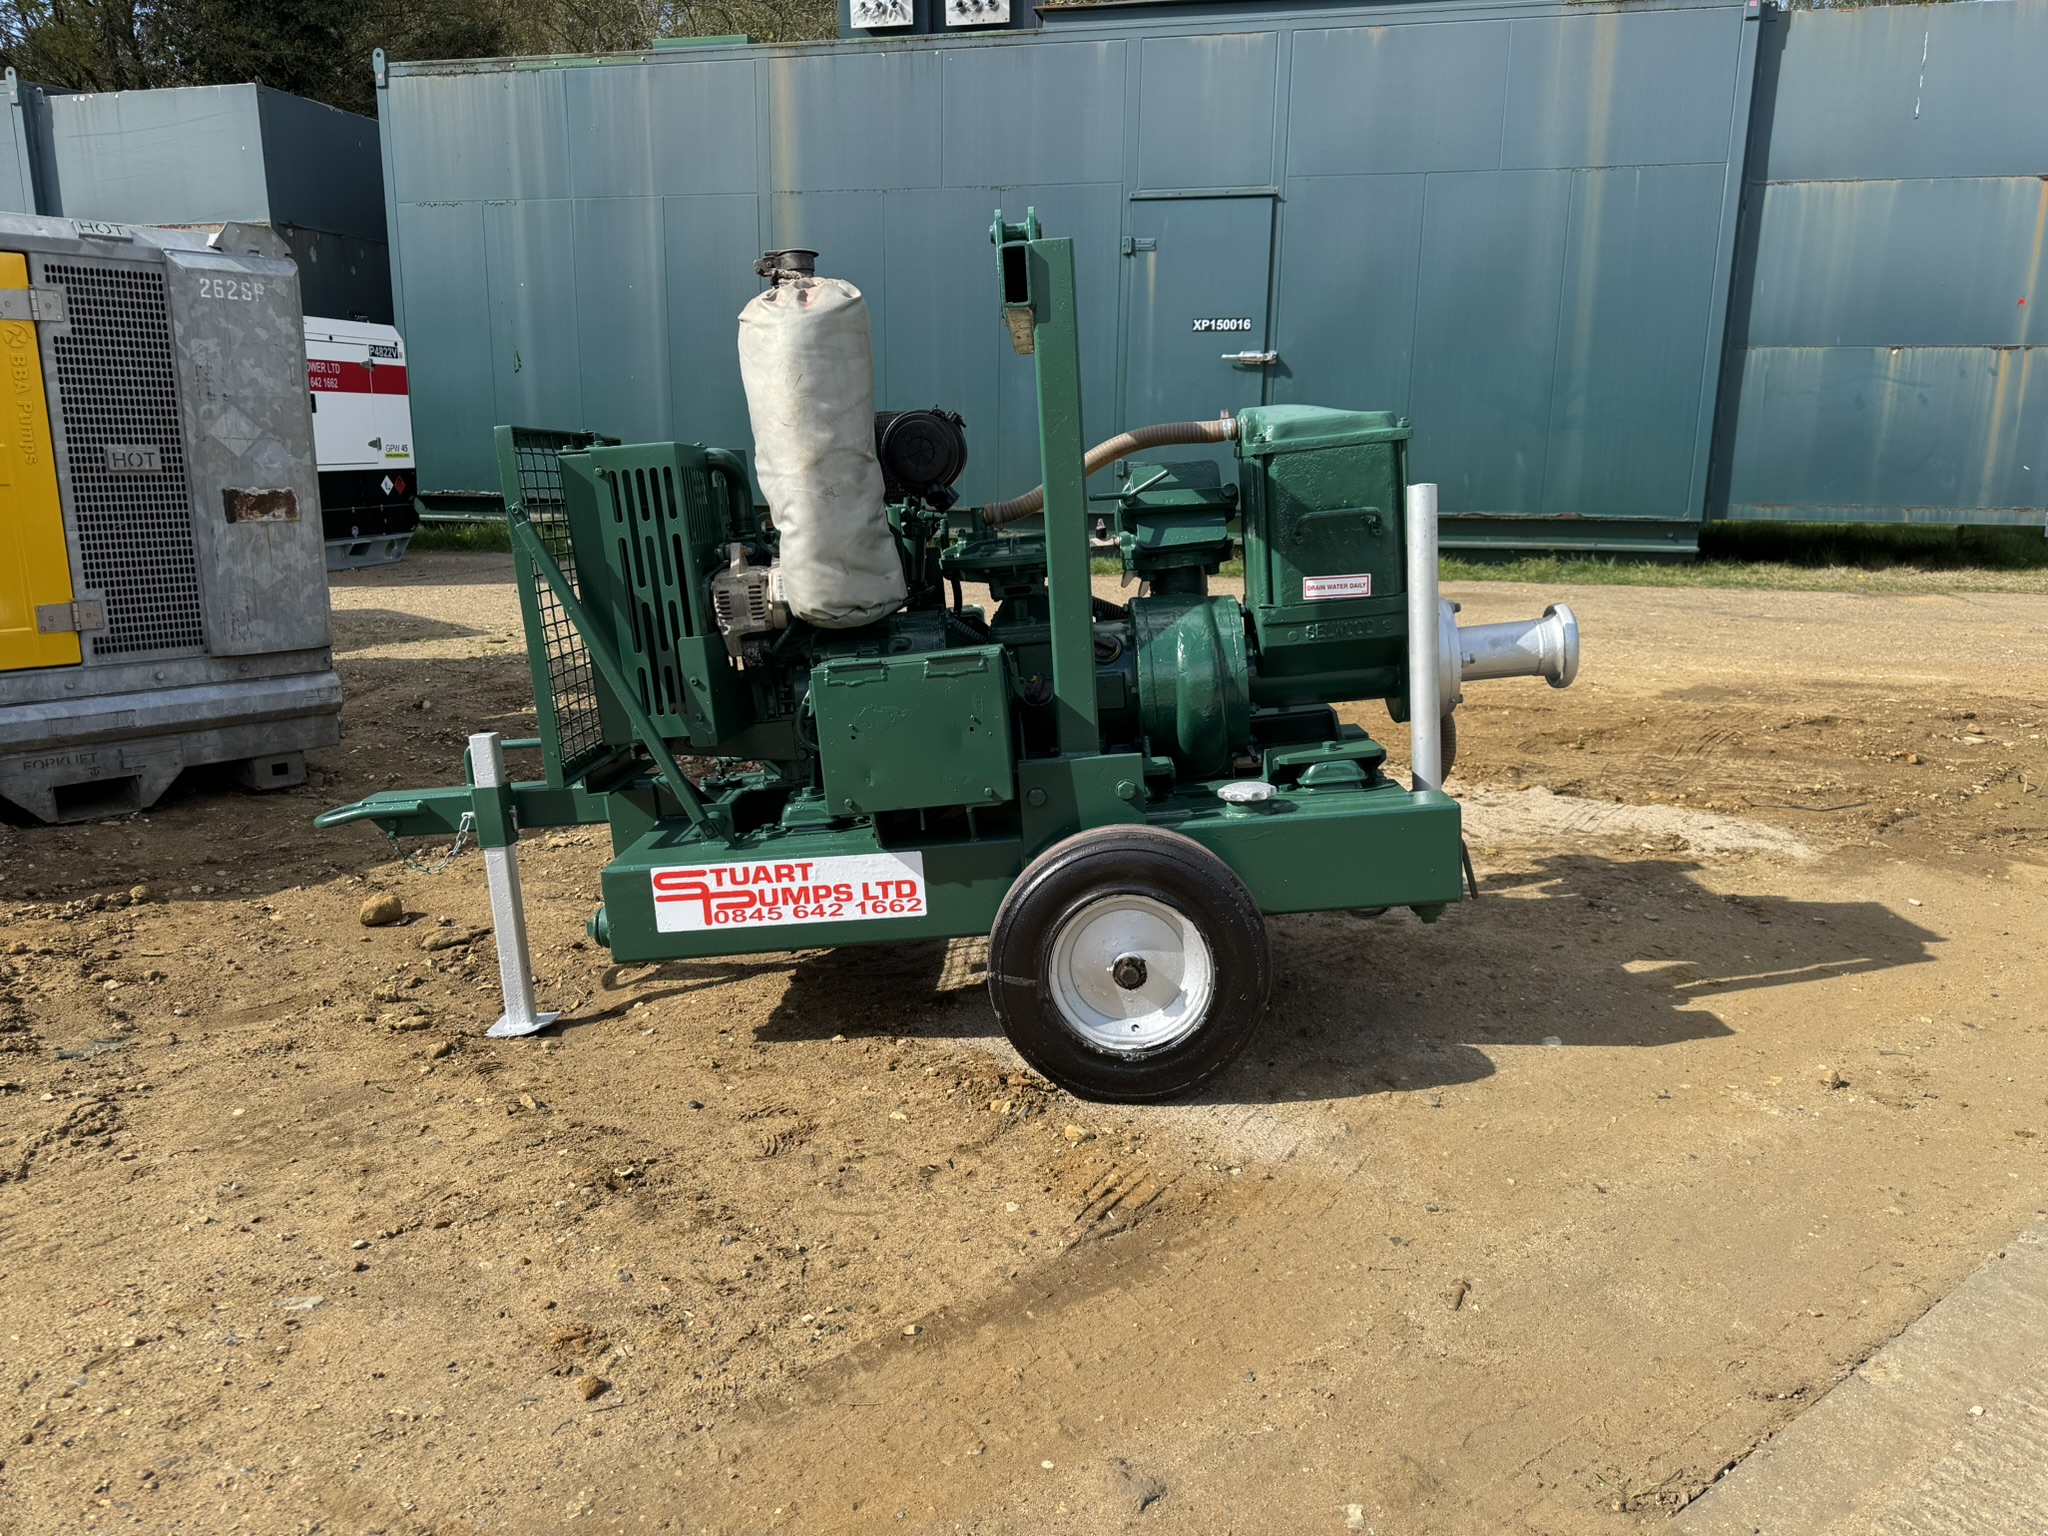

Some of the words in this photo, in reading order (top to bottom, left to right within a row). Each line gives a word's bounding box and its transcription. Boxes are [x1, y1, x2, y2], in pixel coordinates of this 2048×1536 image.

[79, 221, 122, 236] HOT
[1192, 318, 1251, 331] XP150016
[369, 345, 398, 358] P4822V
[10, 352, 31, 395] BBA
[306, 361, 326, 373] OWER
[327, 363, 341, 374] LTD
[310, 376, 322, 388] 642
[16, 400, 38, 466] Pumps
[401, 444, 409, 452] 45
[112, 452, 155, 468] HOT
[653, 863, 813, 903] STUART
[703, 883, 853, 926] PUMPS
[861, 879, 918, 901] LTD
[714, 906, 783, 924] 0845
[792, 903, 844, 919] 642
[855, 898, 923, 915] 1662
